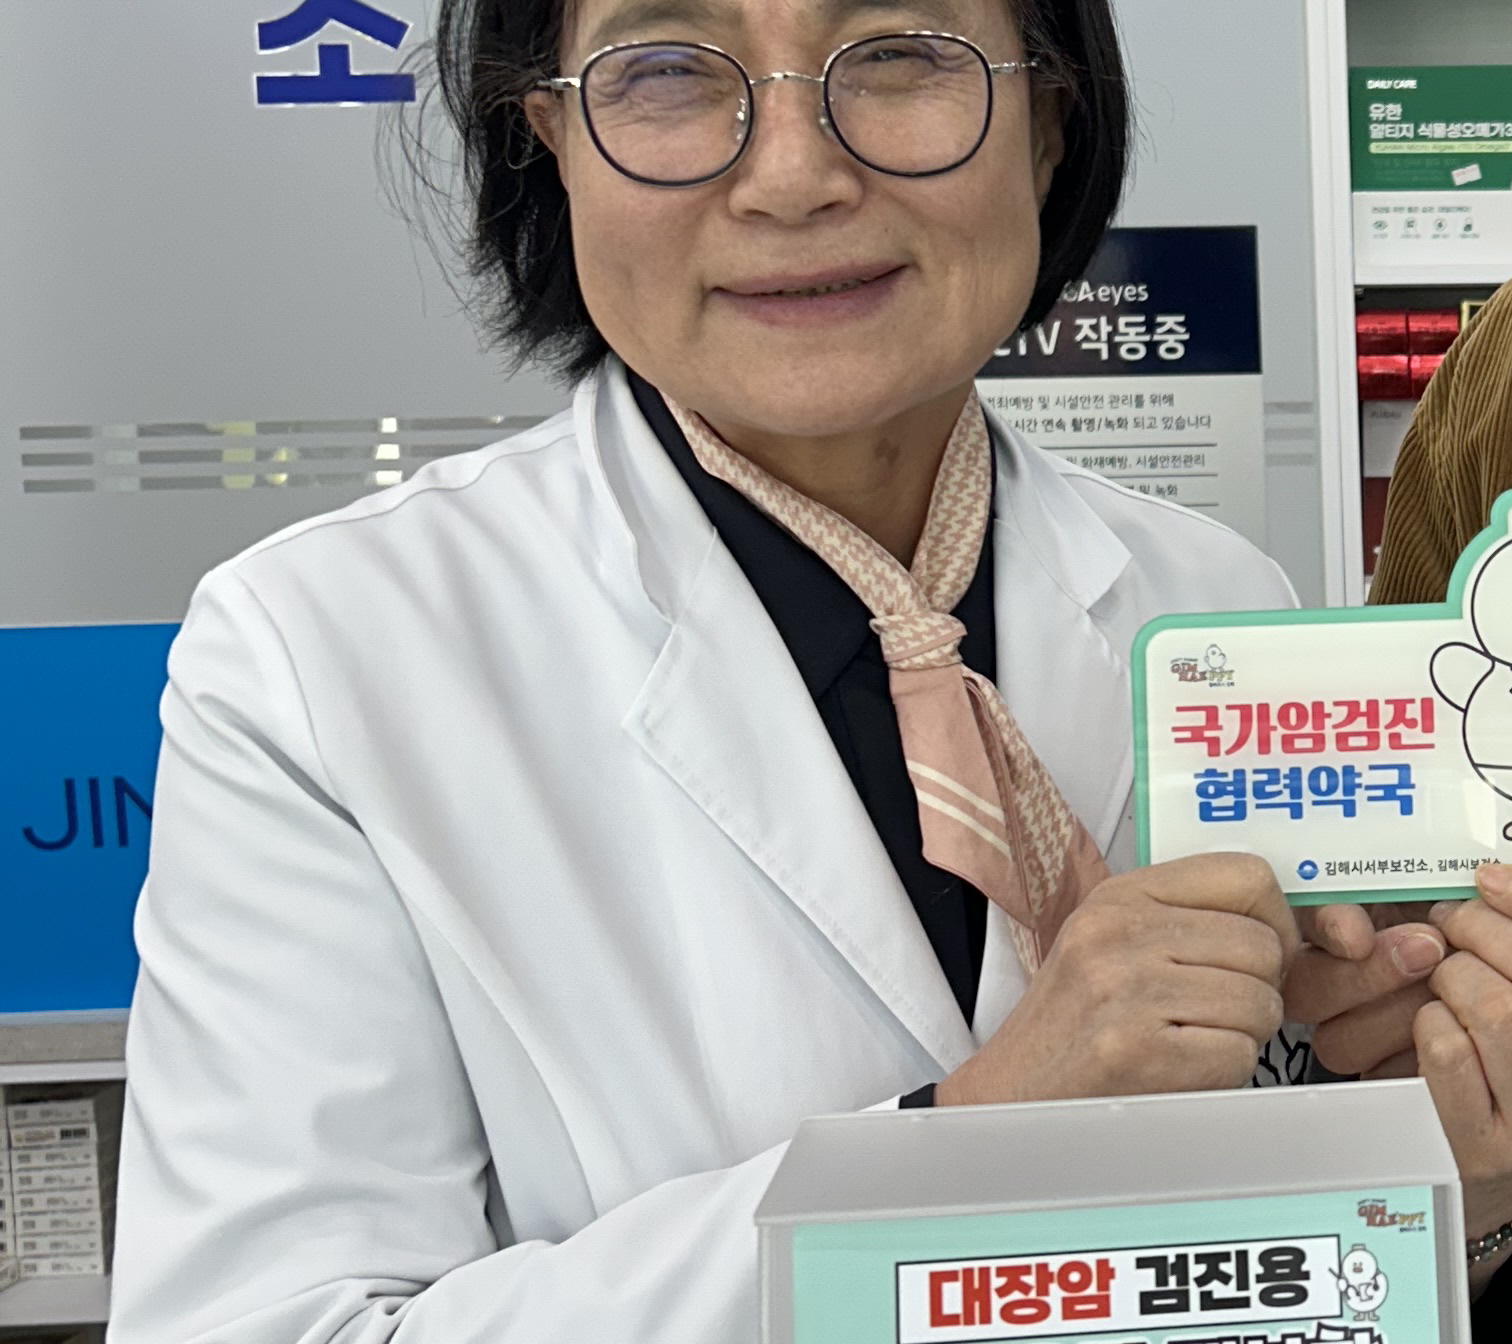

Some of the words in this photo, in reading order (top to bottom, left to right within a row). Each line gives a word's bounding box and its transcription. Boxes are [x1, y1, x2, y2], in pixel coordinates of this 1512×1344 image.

[1369, 102, 1402, 121] 유한
[1075, 314, 1190, 361] 작동중
[1038, 396, 1050, 409] 및
[1055, 394, 1104, 410] 시설안전
[1108, 394, 1145, 409] 관리를
[1150, 393, 1175, 407] 위해
[1133, 416, 1157, 430] 되고
[1161, 414, 1212, 431] 있습니다
[1136, 454, 1206, 469] 시설안전관리
[1171, 697, 1436, 758] 국가암검진
[1193, 763, 1416, 823] 협력약국
[22, 775, 153, 851] JIN
[1324, 858, 1434, 877] 김해시서부보건소,
[928, 1260, 1115, 1328] 대장암
[1135, 1246, 1310, 1314] 검진용
